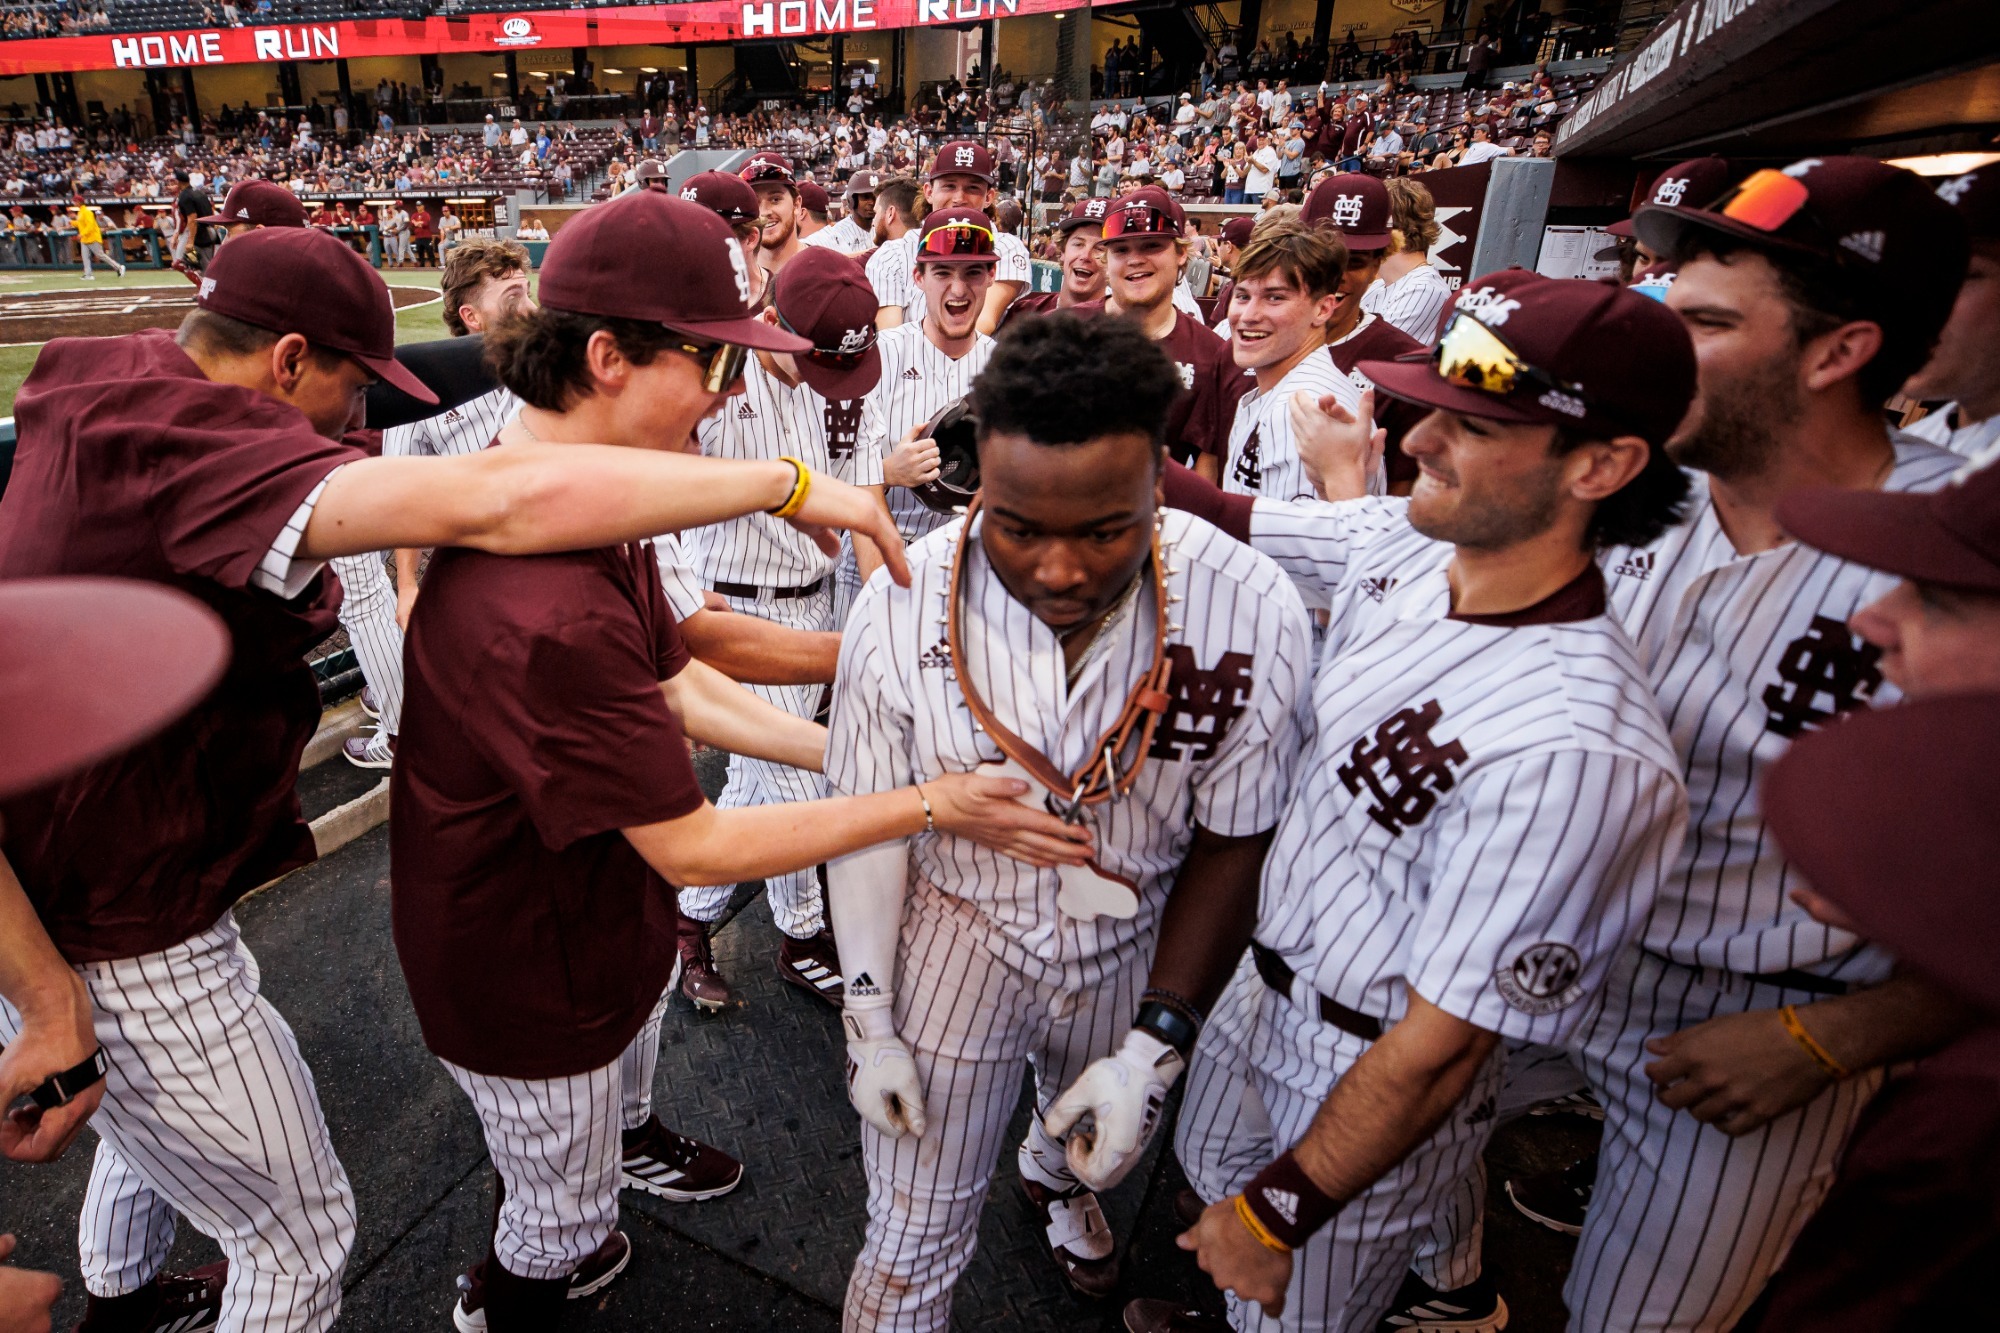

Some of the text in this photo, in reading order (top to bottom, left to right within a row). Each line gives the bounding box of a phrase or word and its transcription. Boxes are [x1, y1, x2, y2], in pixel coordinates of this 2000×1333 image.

[742, 0, 876, 36] HOME
[111, 26, 339, 67] HOME RUN
[500, 106, 517, 117] 105
[763, 100, 780, 111] 106
[849, 986, 881, 996] adidas
[1261, 1187, 1298, 1226] adidas
